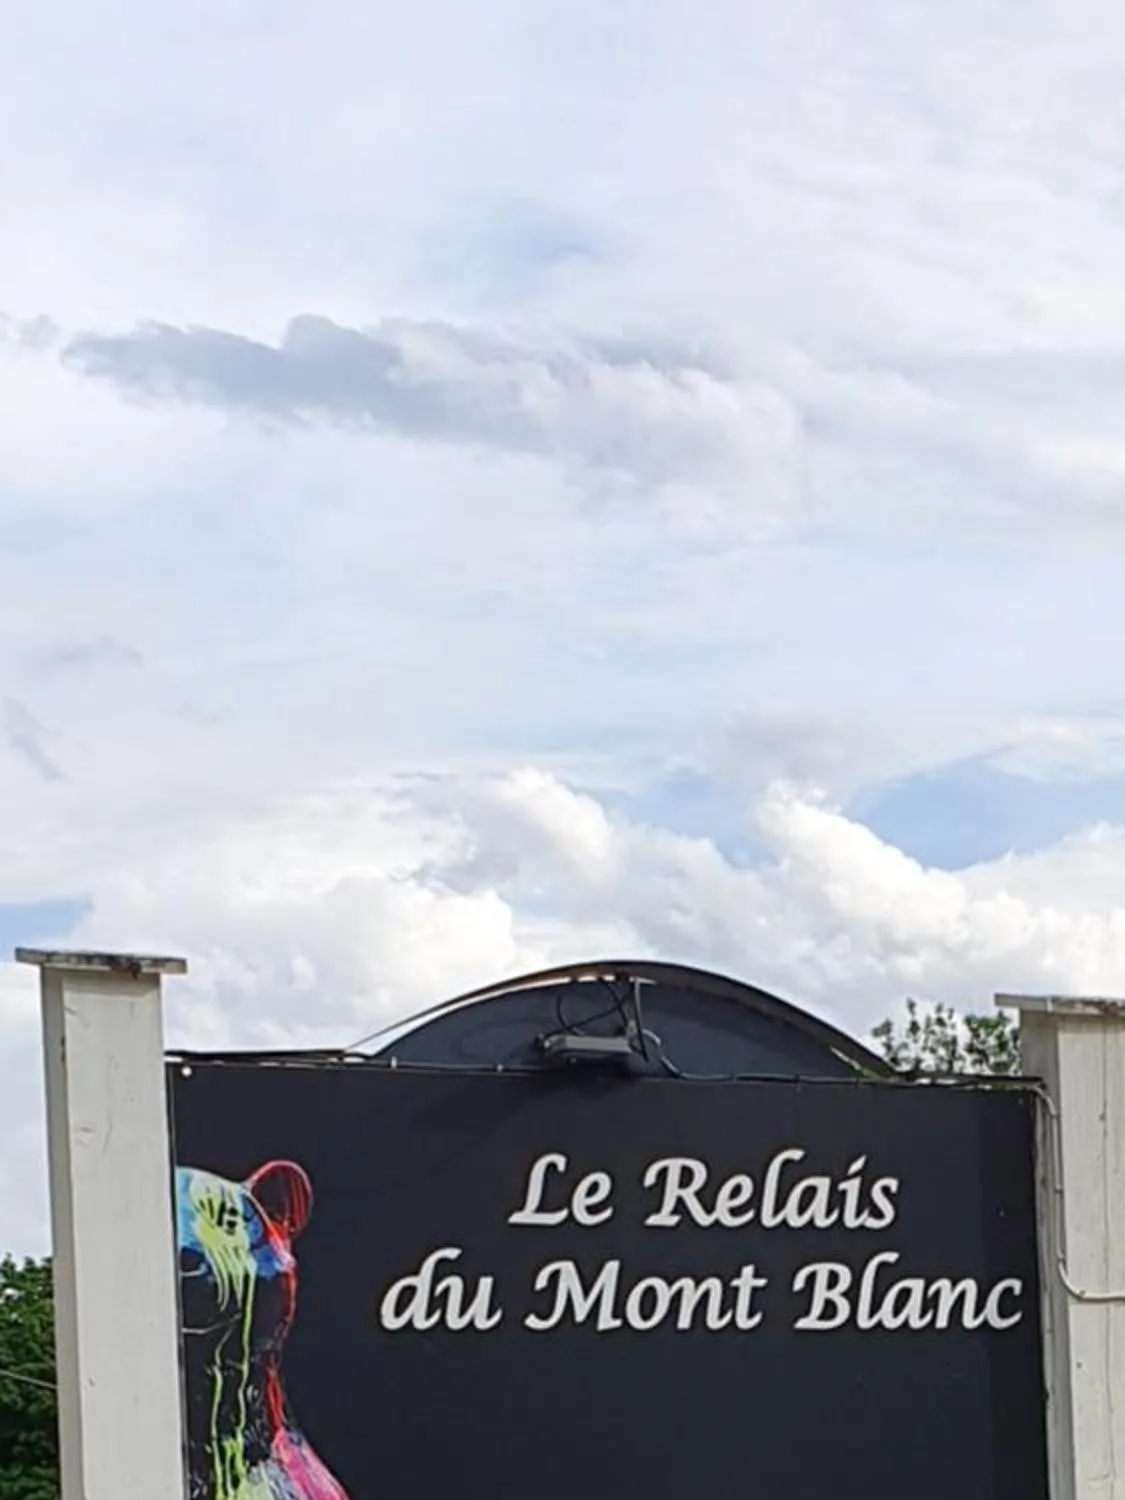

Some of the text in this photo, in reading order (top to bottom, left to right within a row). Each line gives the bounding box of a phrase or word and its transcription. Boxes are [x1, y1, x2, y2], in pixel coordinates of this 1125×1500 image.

[508, 1148, 899, 1229] Le Relais
[380, 1246, 1022, 1331] du Mont Blanc
